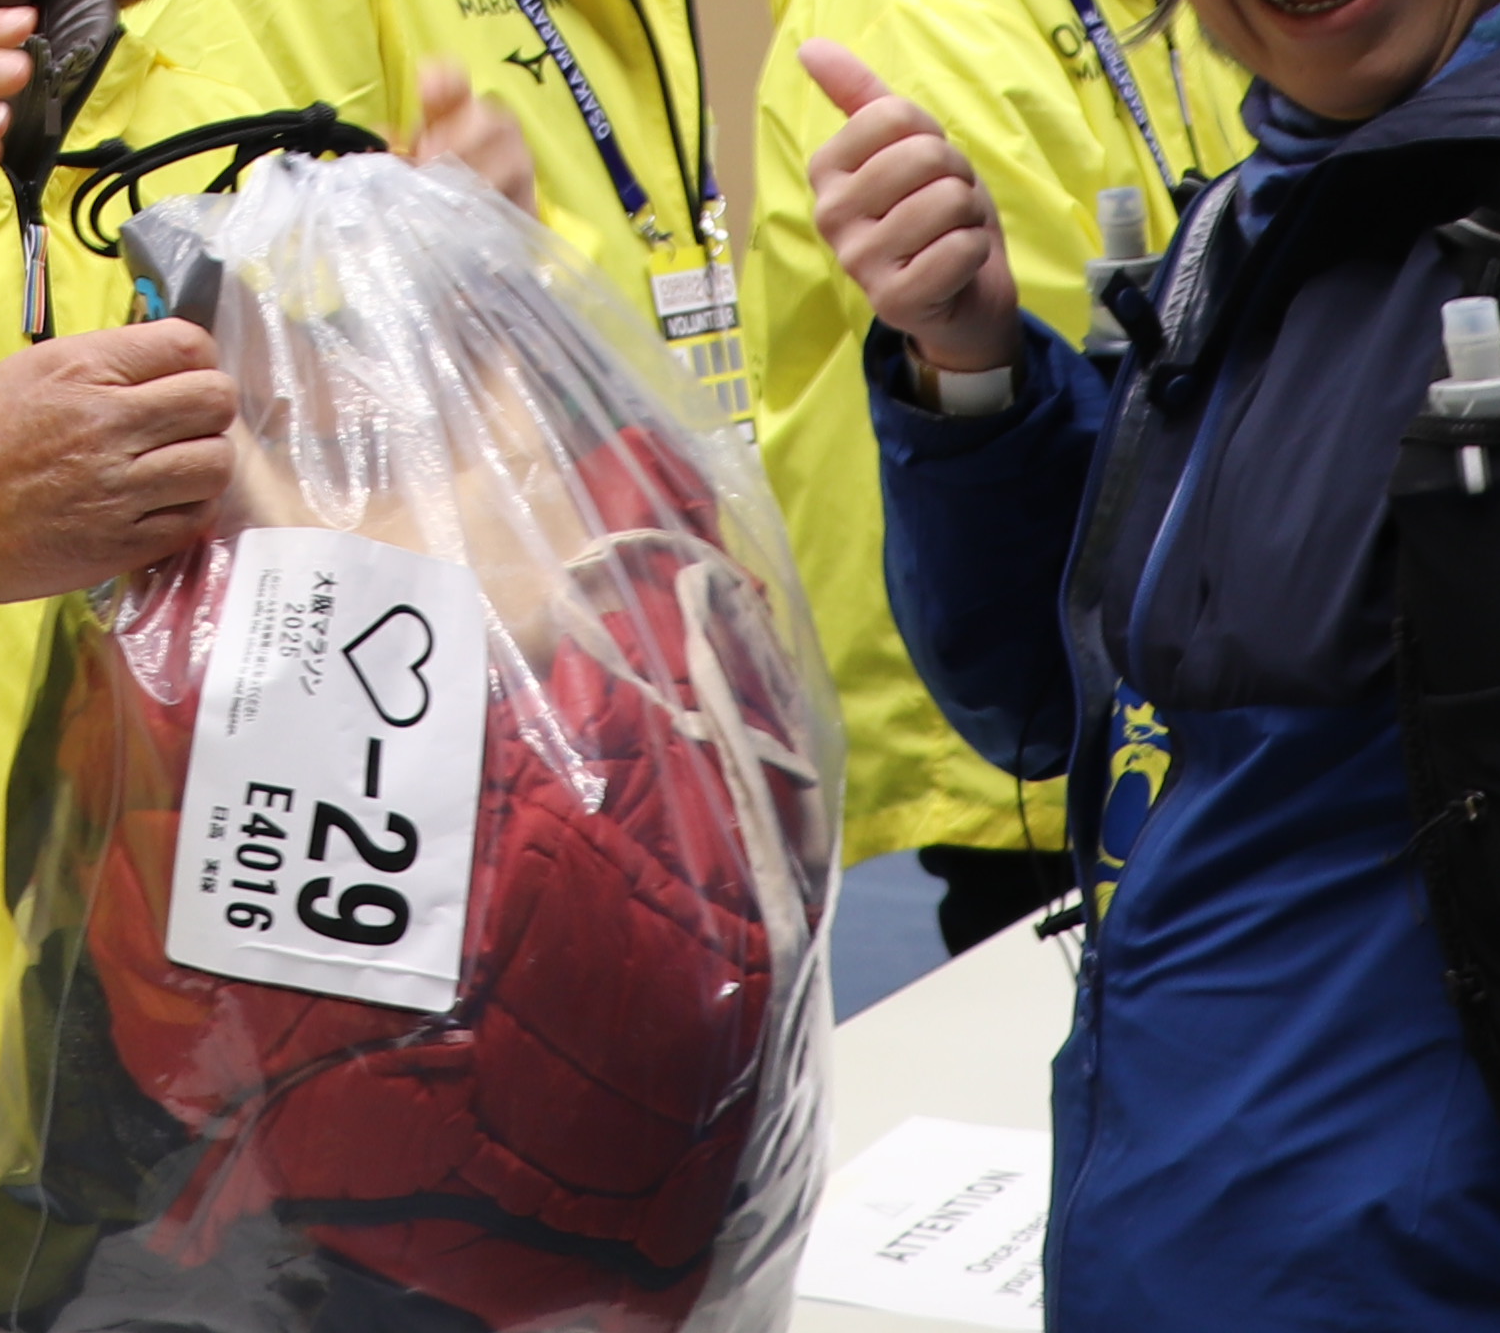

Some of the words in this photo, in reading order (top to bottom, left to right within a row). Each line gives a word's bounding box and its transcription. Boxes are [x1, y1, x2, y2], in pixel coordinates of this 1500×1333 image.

[568, 65, 611, 141] OSAKA
[280, 602, 307, 659] 2025
[302, 570, 340, 697] 大阪マラソン
[225, 780, 296, 933] E4016
[874, 1169, 1027, 1265] ATTENTION
